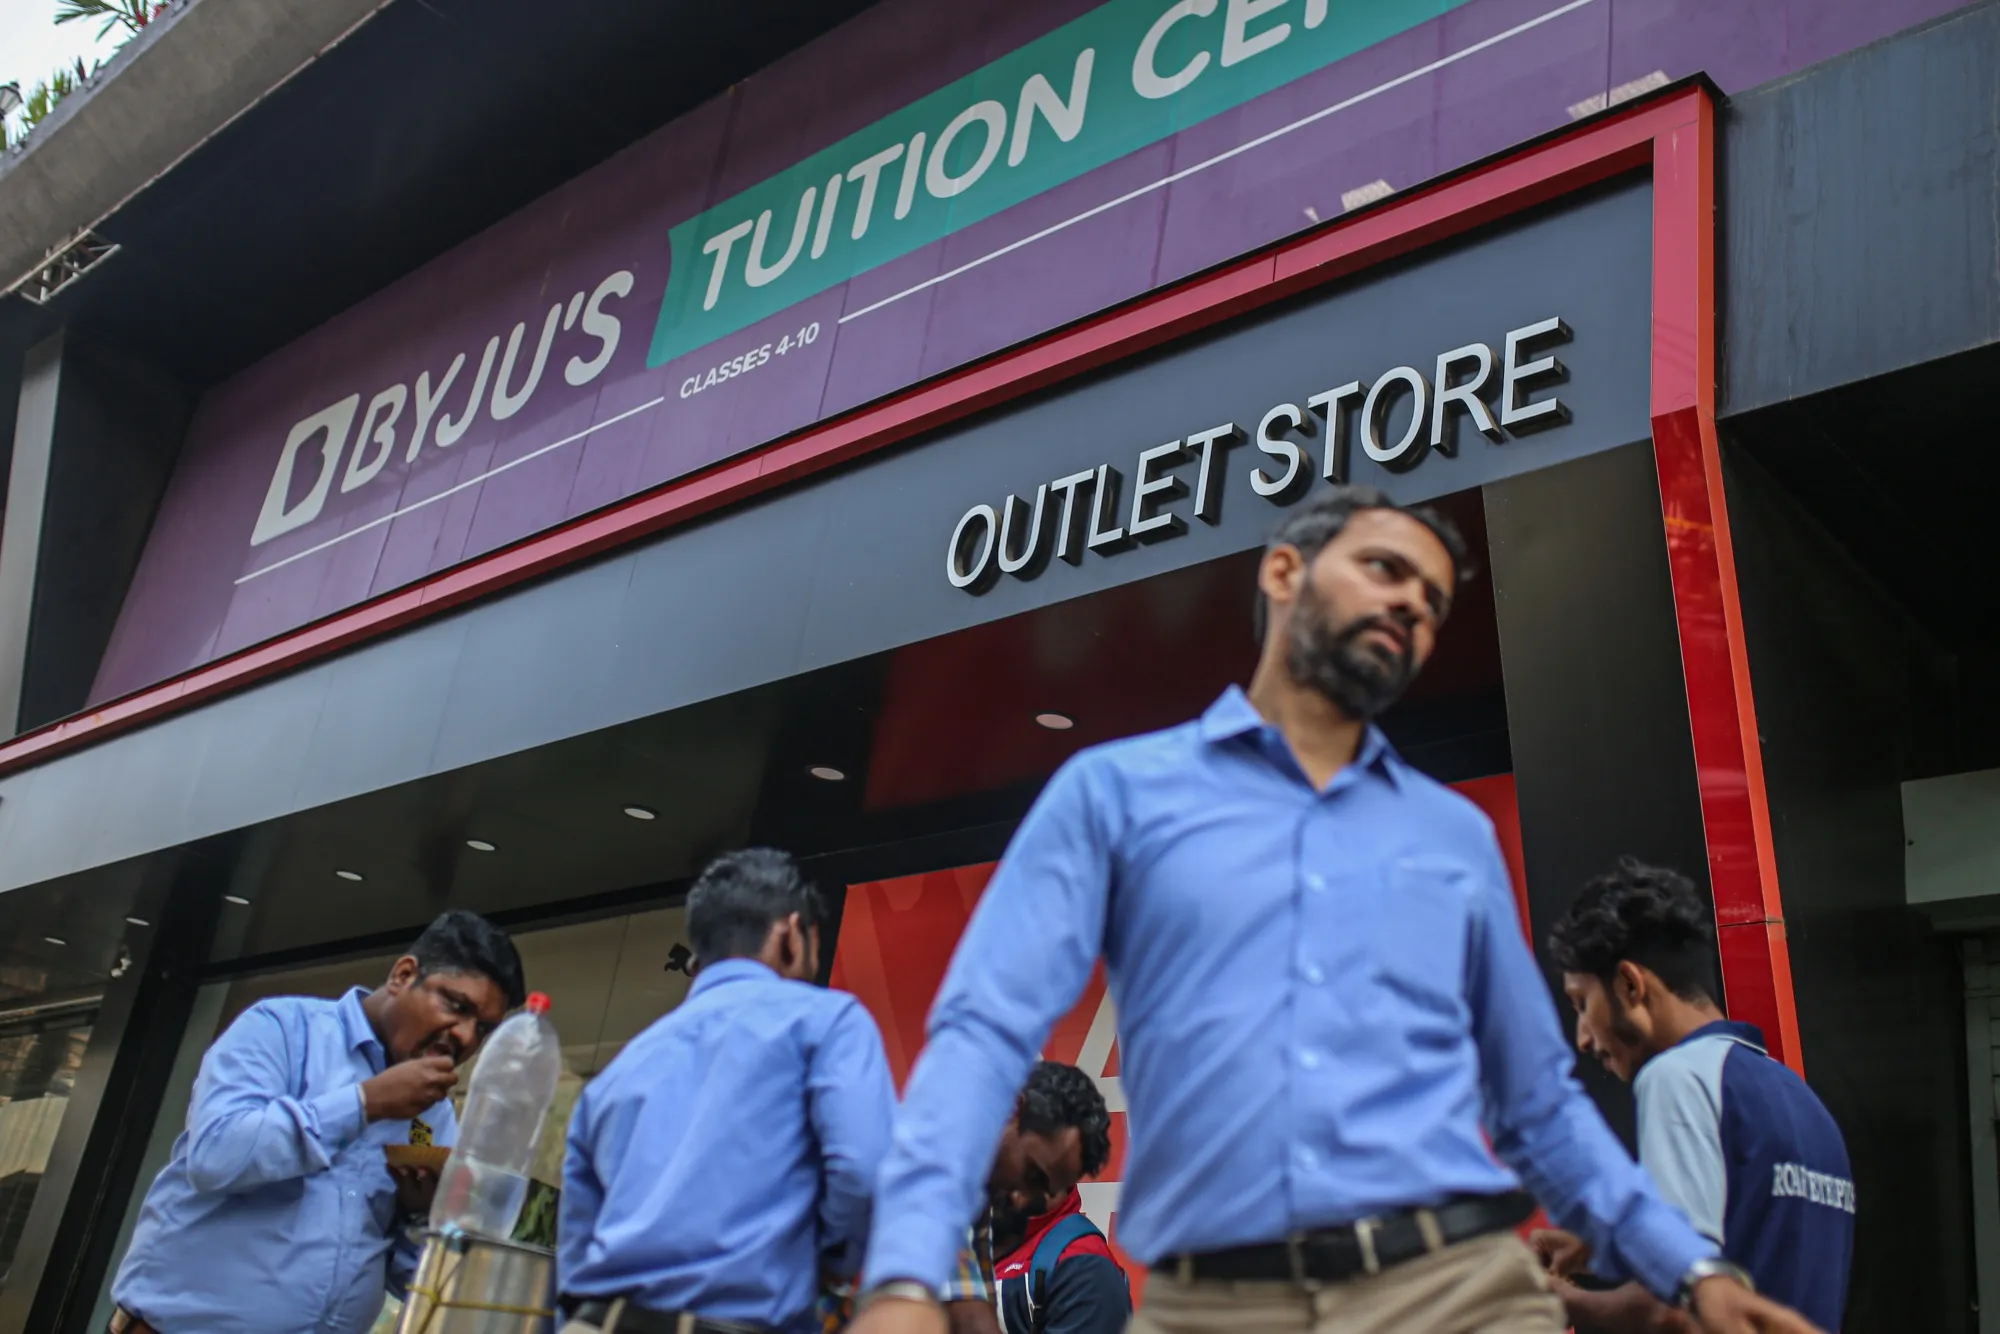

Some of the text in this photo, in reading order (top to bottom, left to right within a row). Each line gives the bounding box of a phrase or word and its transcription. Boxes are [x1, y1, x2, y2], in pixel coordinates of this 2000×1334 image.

[340, 270, 634, 494] BYJU'S
[702, 47, 1095, 311] TUITION
[680, 321, 820, 399] CLASSES 4-10
[946, 316, 1571, 593] OUTLET STORE
